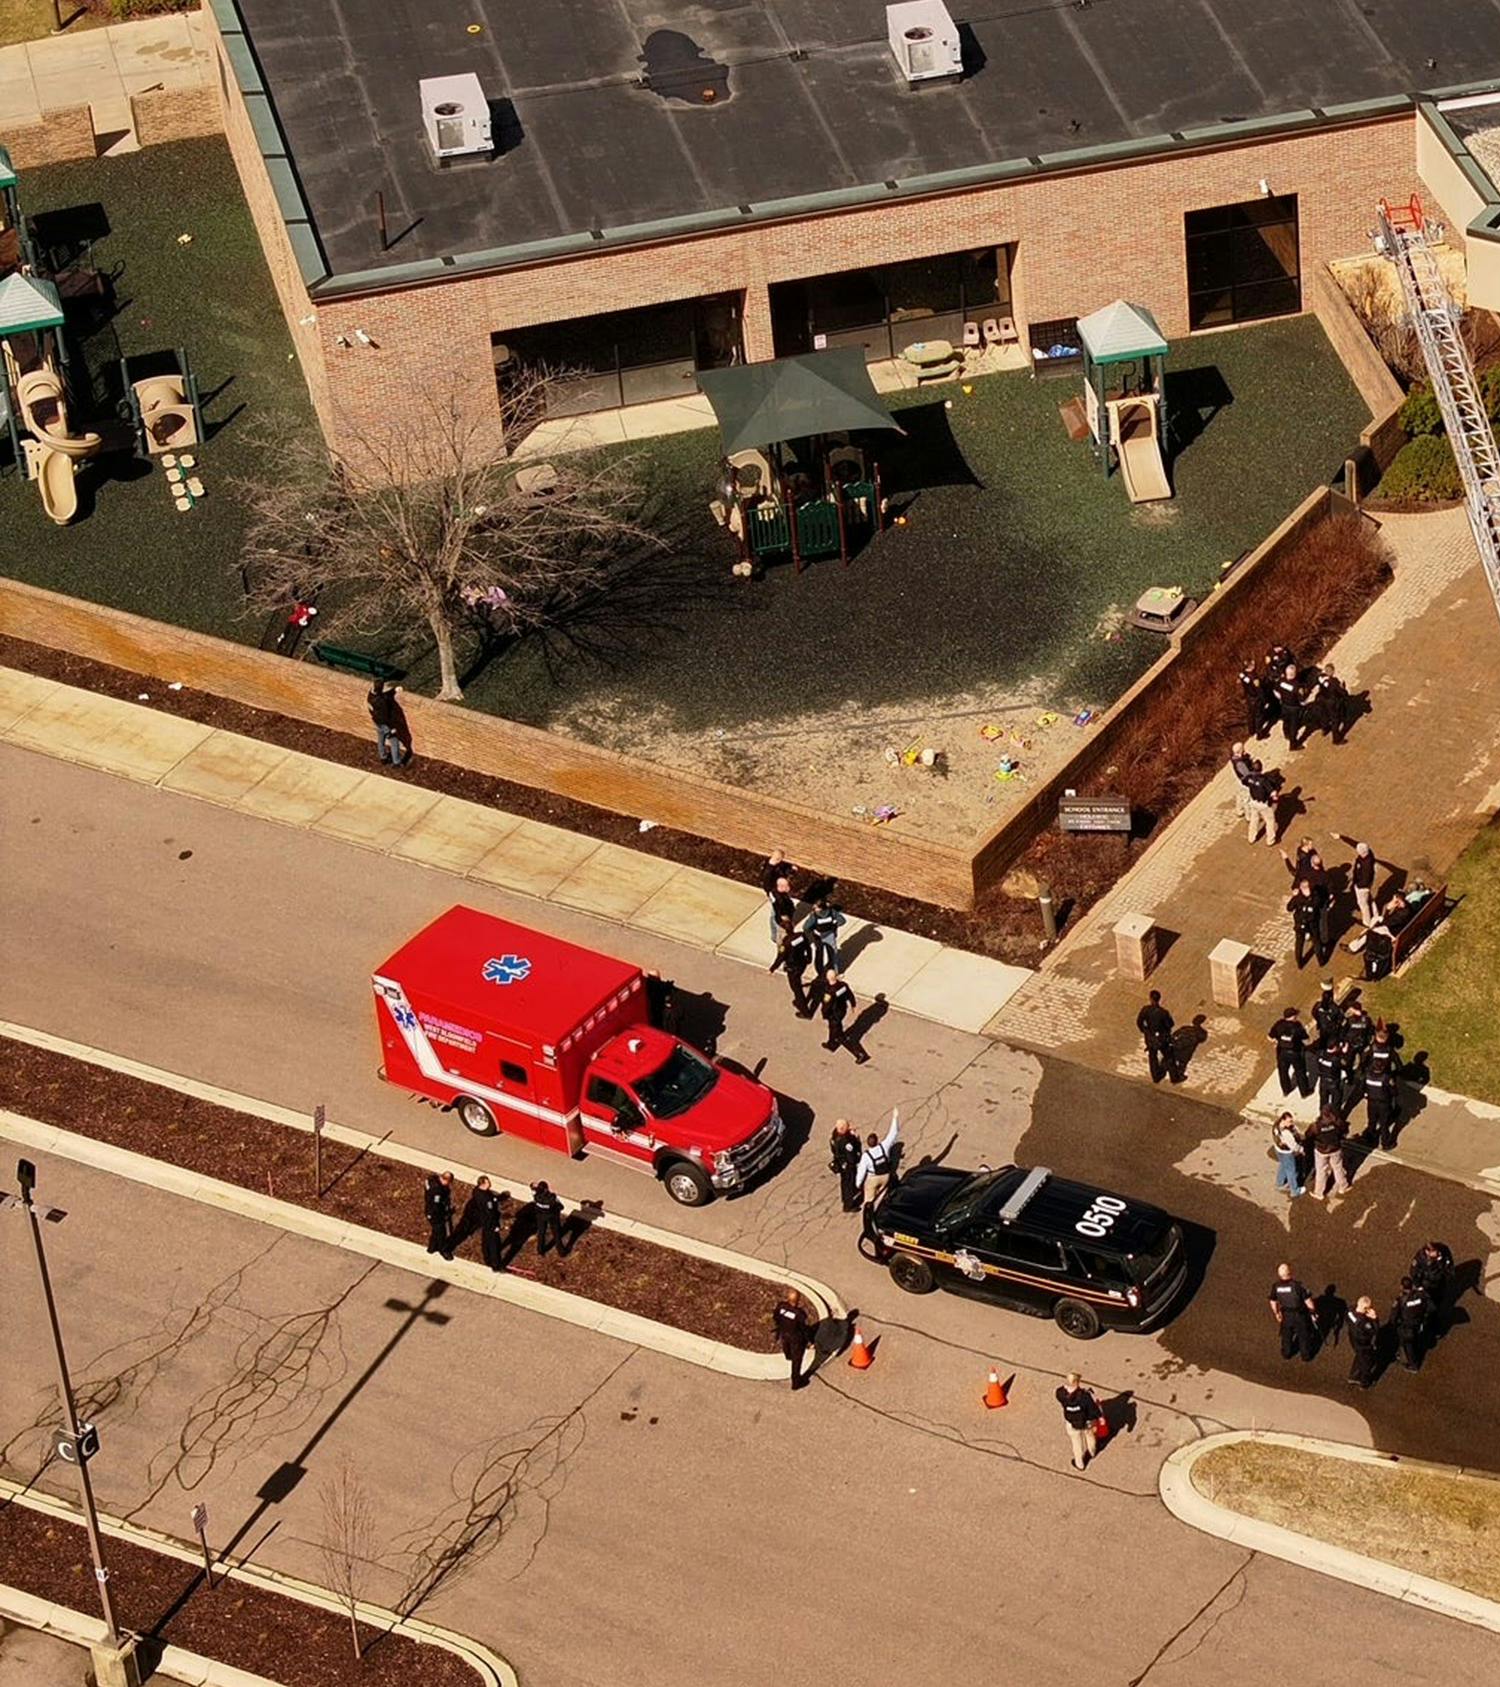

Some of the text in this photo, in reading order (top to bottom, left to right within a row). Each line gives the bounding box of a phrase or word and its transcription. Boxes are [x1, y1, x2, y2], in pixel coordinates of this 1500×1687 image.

[1075, 1196, 1127, 1237] 0510
[58, 1442, 75, 1462] C
[81, 1434, 95, 1456] C
